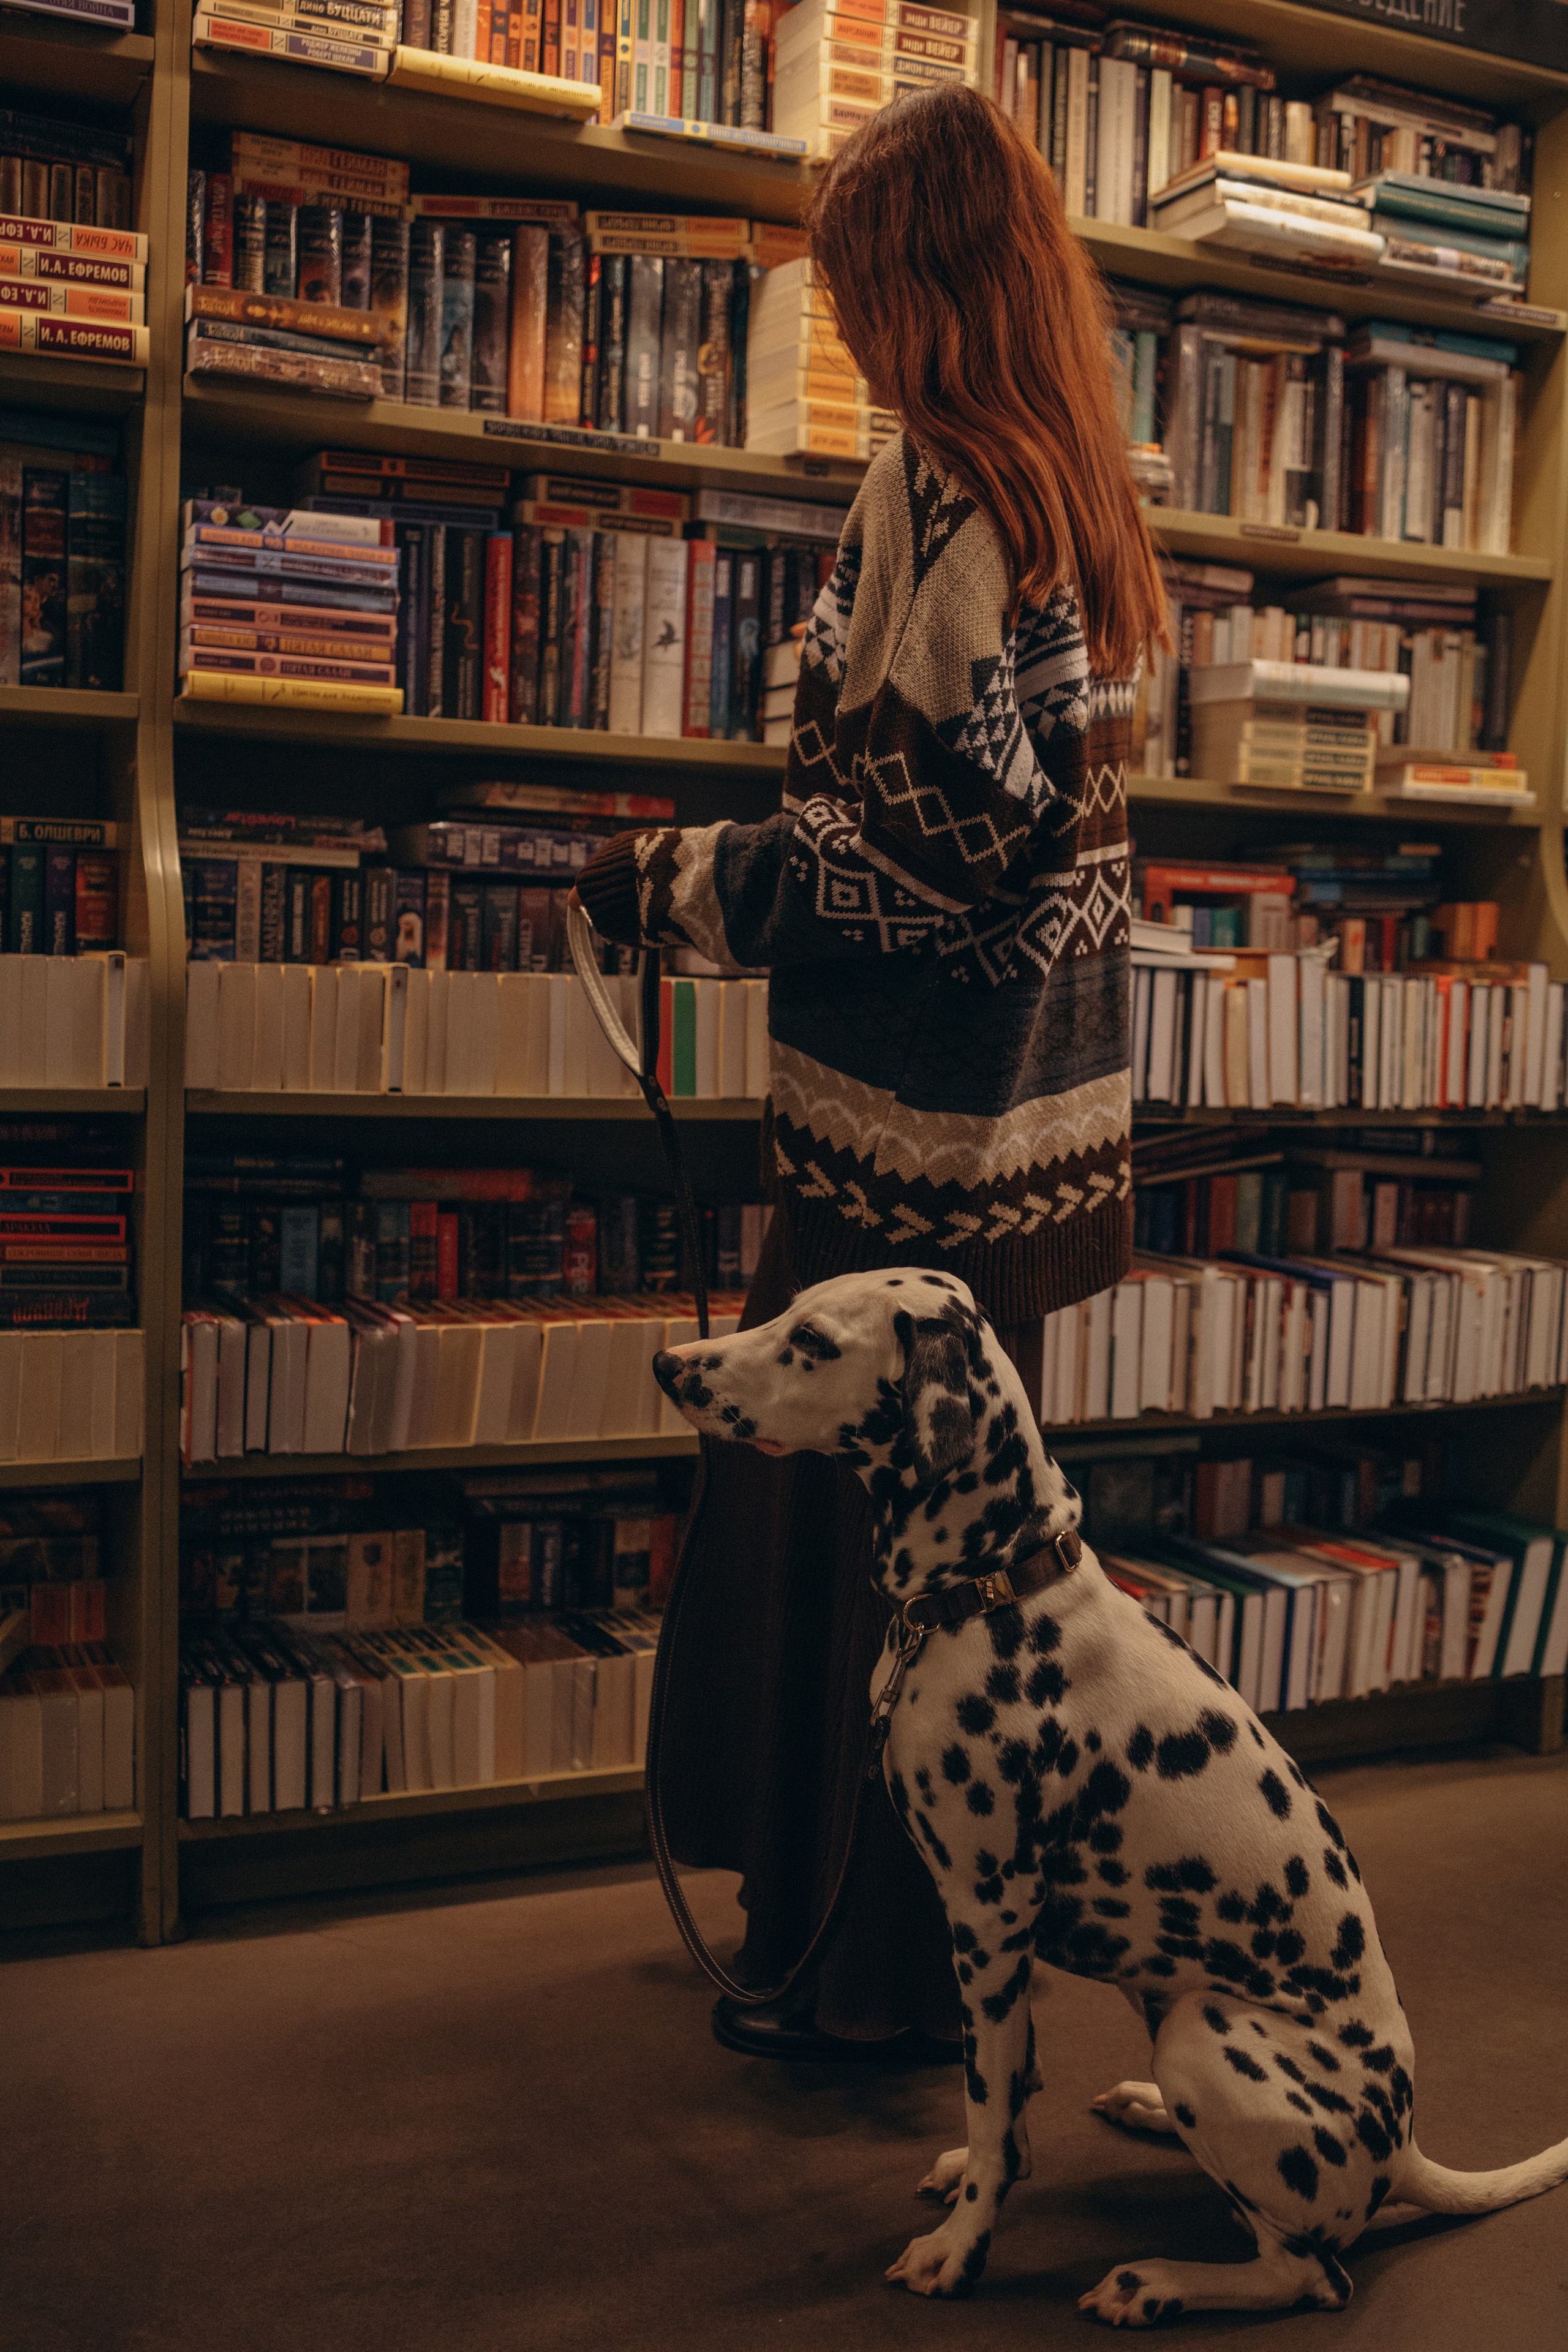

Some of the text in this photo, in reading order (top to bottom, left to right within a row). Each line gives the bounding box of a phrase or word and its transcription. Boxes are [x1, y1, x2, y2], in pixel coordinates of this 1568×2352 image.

[300, 1, 380, 25] ДИНО БУЦЦАТИ
[905, 12, 962, 35] ЭНДИ ВЕЙЕР
[437, 9, 450, 53] ТОРИЯ
[301, 39, 328, 49] РОДЖЕР
[307, 50, 331, 59] РОБЕРТ
[902, 37, 959, 60] ЭНДИ ВЕЙЕР
[76, 233, 134, 253] ЧАС БЫКА
[40, 258, 129, 283] И.А. ЕФРЕМОВ
[70, 331, 131, 352] ЕФРЕМОВ
[20, 824, 102, 843] Б. ОЛШЕВРИ
